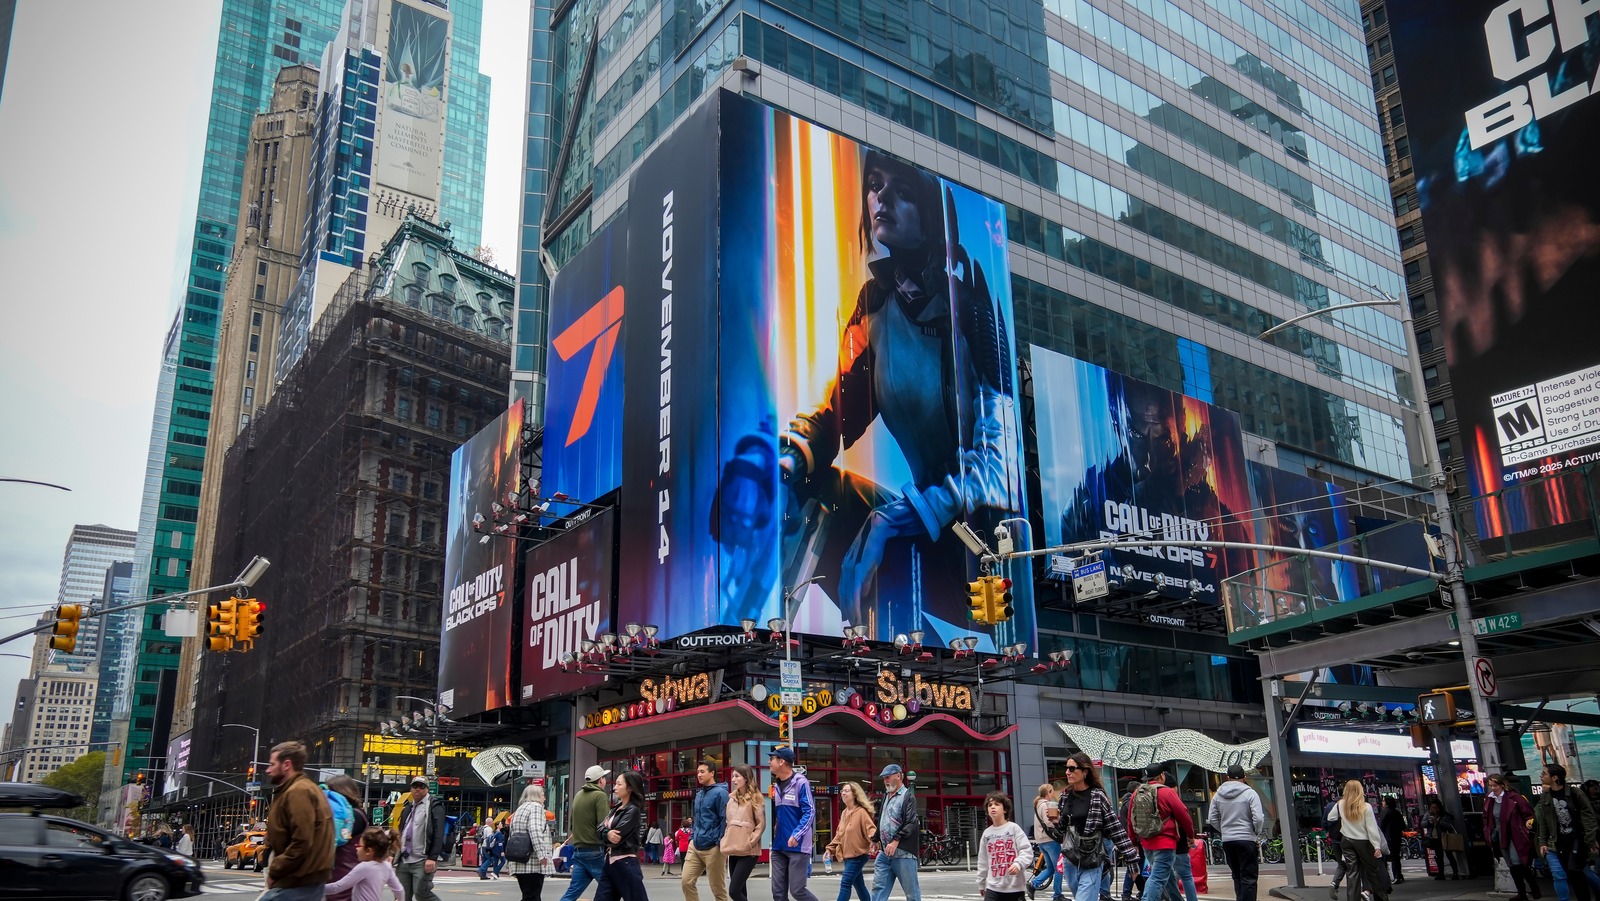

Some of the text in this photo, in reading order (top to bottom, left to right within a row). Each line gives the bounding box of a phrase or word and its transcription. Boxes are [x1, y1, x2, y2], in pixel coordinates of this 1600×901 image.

[394, 129, 427, 144] ELEMENTS
[395, 122, 427, 137] NATURAL
[387, 134, 433, 152] MASTERFULLY
[552, 285, 624, 448] 7
[658, 190, 674, 565] NOVEMBER 14
[1541, 378, 1576, 393] Intense
[1493, 388, 1534, 404] MATURE 17+
[1543, 391, 1570, 404] Blood
[1574, 385, 1592, 396] and
[1545, 396, 1599, 415] Suggestive
[1497, 402, 1540, 442] M
[1548, 412, 1579, 426] Strong
[1550, 427, 1569, 437] Use
[1571, 423, 1581, 432] of
[1501, 438, 1545, 454] ESRB
[1508, 448, 1548, 463] In-Game
[1540, 461, 1563, 473] 2025
[1104, 500, 1153, 538] CALL
[1149, 515, 1161, 529] OF
[1167, 546, 1204, 567] OPS
[1205, 553, 1217, 568] 7
[1090, 564, 1102, 572] LANE
[449, 581, 470, 615] CALL
[469, 582, 475, 596] OF
[531, 556, 581, 622] CALL
[446, 591, 505, 632] BLACK OPS 7
[1488, 615, 1518, 631] W 42 St
[530, 600, 600, 670] OF DUTY
[639, 668, 725, 704] Subway
[876, 669, 984, 717] Subway
[1302, 732, 1316, 743] pink
[1357, 736, 1369, 746] pink
[1101, 741, 1164, 765] LOFT
[1218, 748, 1260, 768] LOFT
[1291, 781, 1306, 796] pink
